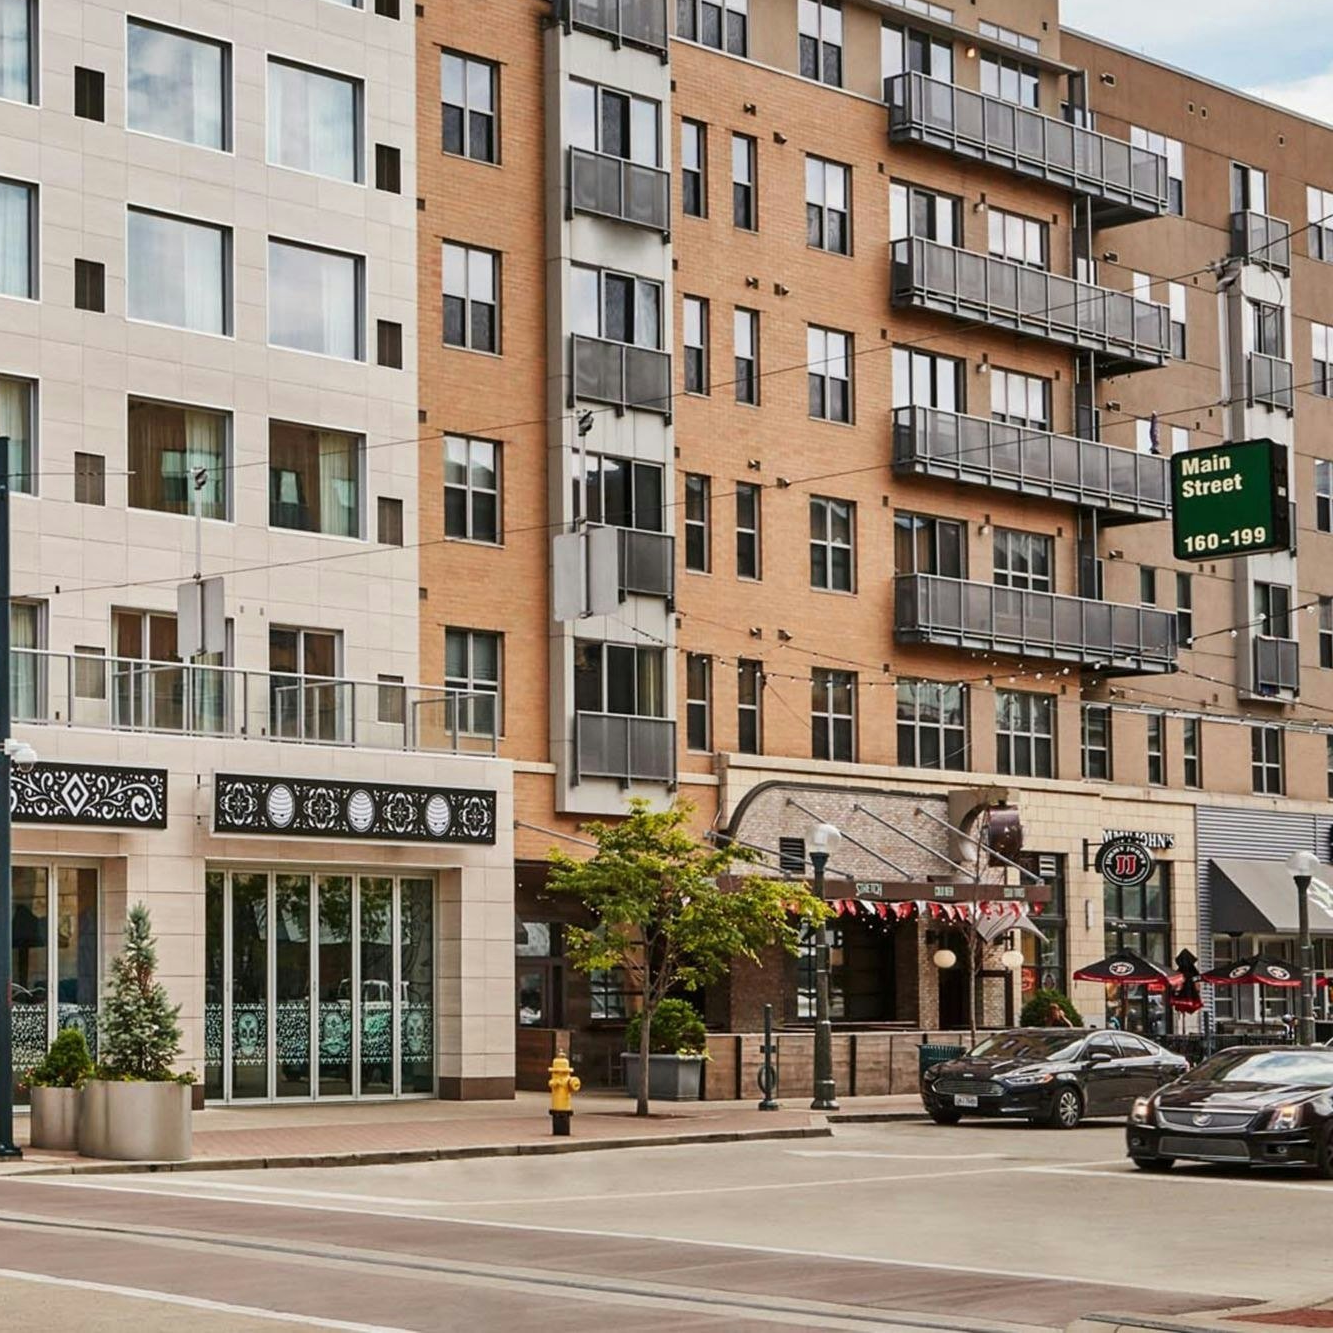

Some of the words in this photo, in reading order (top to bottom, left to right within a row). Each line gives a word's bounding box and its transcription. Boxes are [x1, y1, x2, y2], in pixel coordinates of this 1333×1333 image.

[1181, 454, 1232, 476] Main
[1181, 473, 1243, 498] Street
[1184, 526, 1267, 553] 160-199
[1115, 854, 1138, 875] JJ
